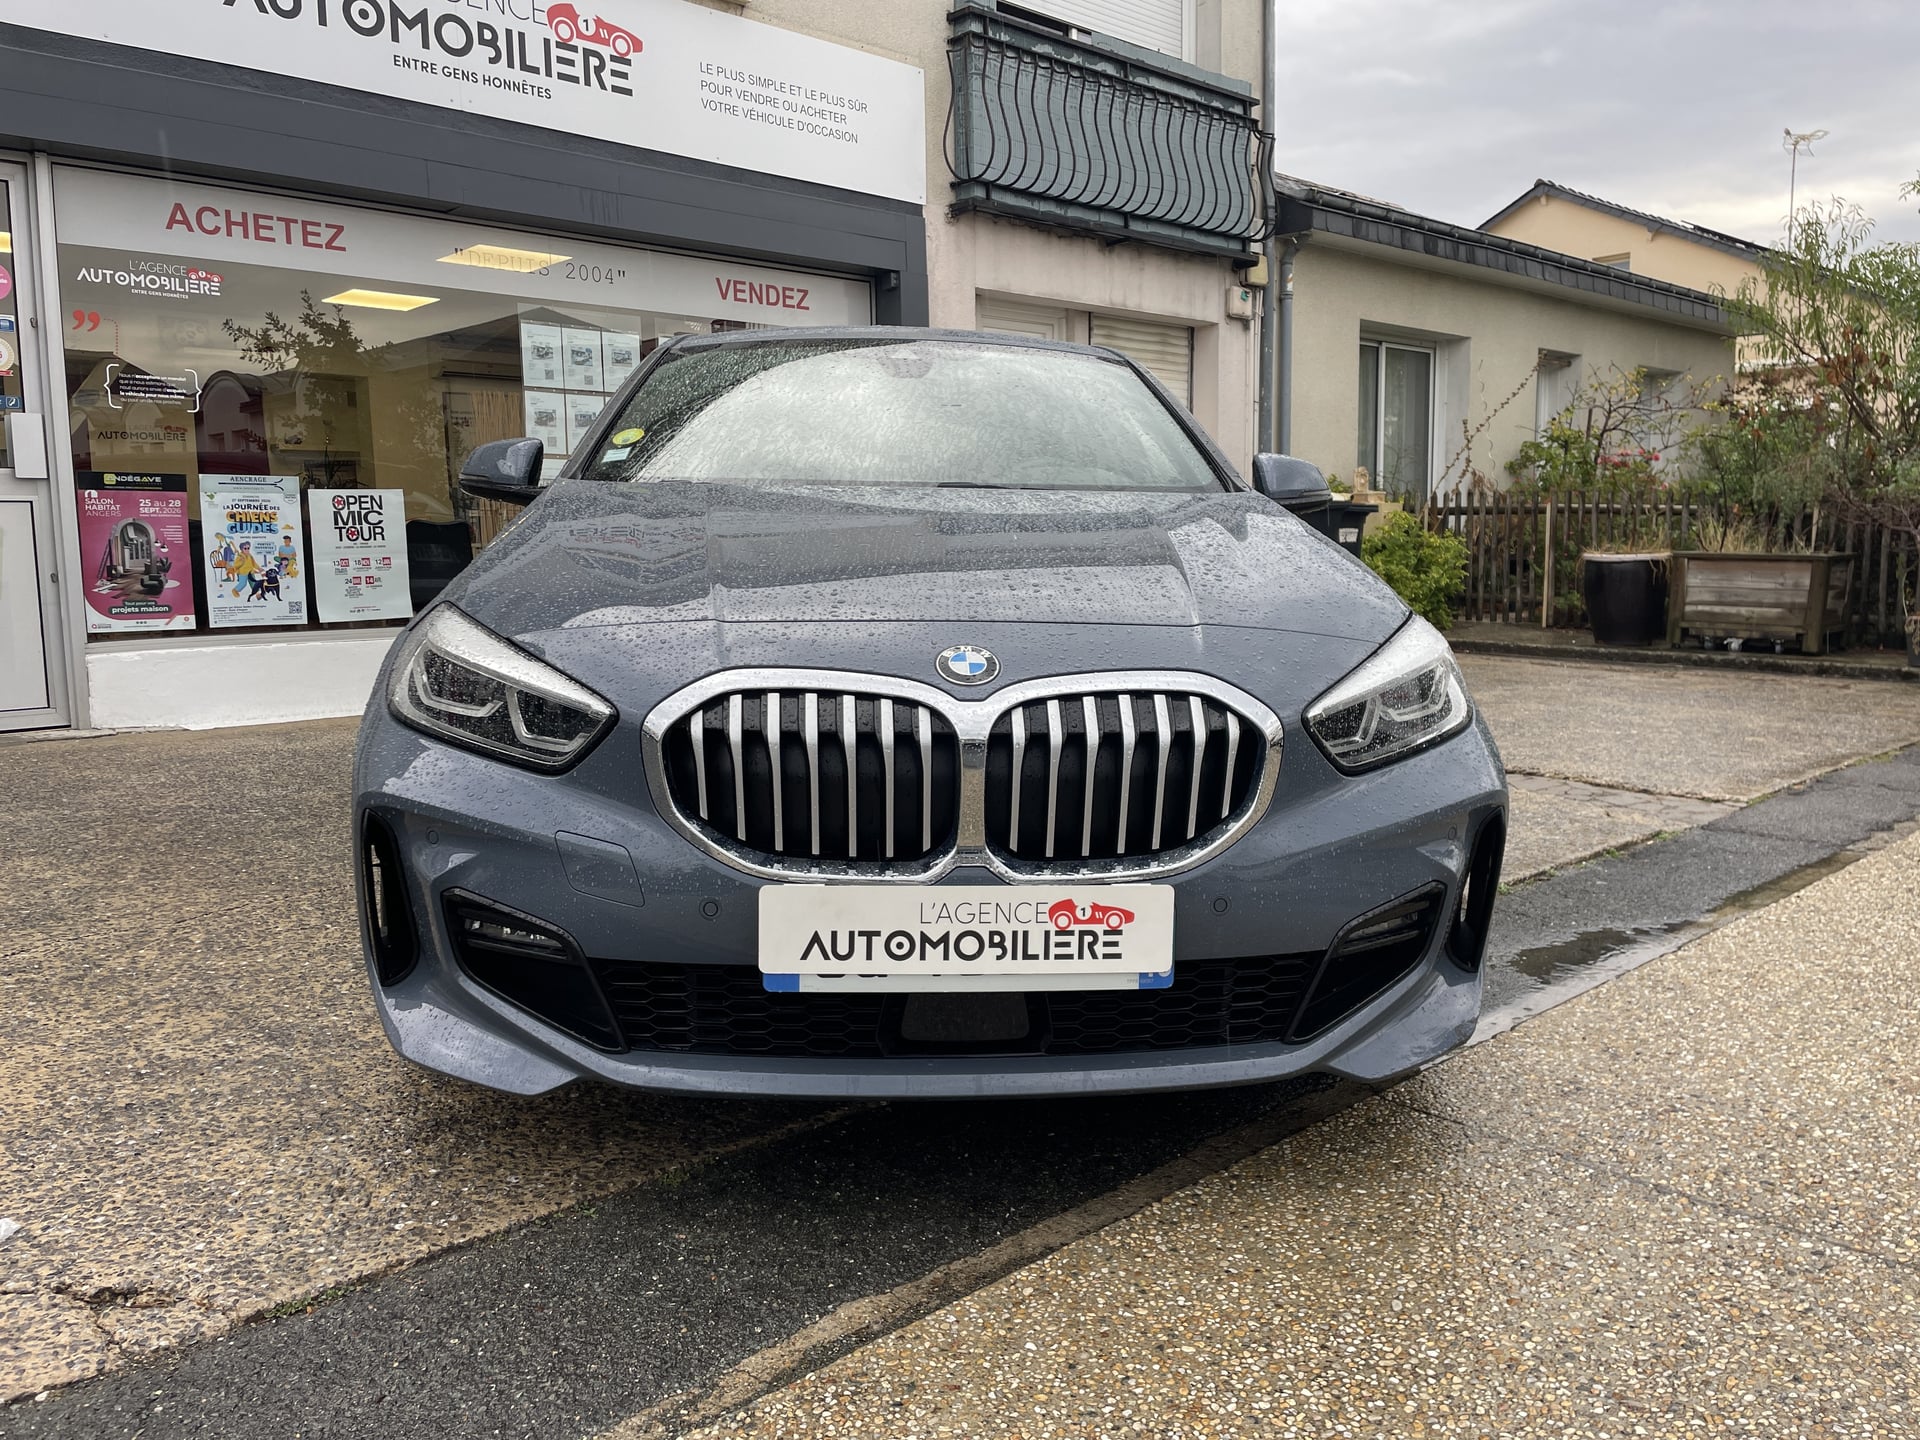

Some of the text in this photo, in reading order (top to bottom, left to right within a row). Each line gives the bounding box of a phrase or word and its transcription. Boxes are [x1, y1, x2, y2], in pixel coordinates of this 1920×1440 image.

[223, 0, 633, 97] TOMOBILIERE
[393, 54, 551, 99] ENTRE GENS HONNÊTES
[700, 61, 868, 114] LE PLUS SIMPLE ET LE PLUS SÛR
[700, 80, 847, 125] POUR VENDRE OU ACHETER
[701, 97, 858, 144] VOTRE VÉHICULE D'OCCASION
[165, 202, 347, 252] ACHETEZ
[129, 259, 187, 277] L'AGENCE
[715, 276, 810, 311] VENDEZ
[139, 499, 151, 507] 25
[168, 499, 181, 507] 28
[230, 502, 269, 511] JOURNÉE
[332, 495, 383, 511] OPEN
[226, 511, 279, 522] CHIENS
[333, 510, 384, 526] MIC
[226, 522, 279, 534] GUIDES
[334, 525, 386, 542] TOUR
[112, 606, 139, 614] projets
[920, 902, 1049, 925] L'AGENCE
